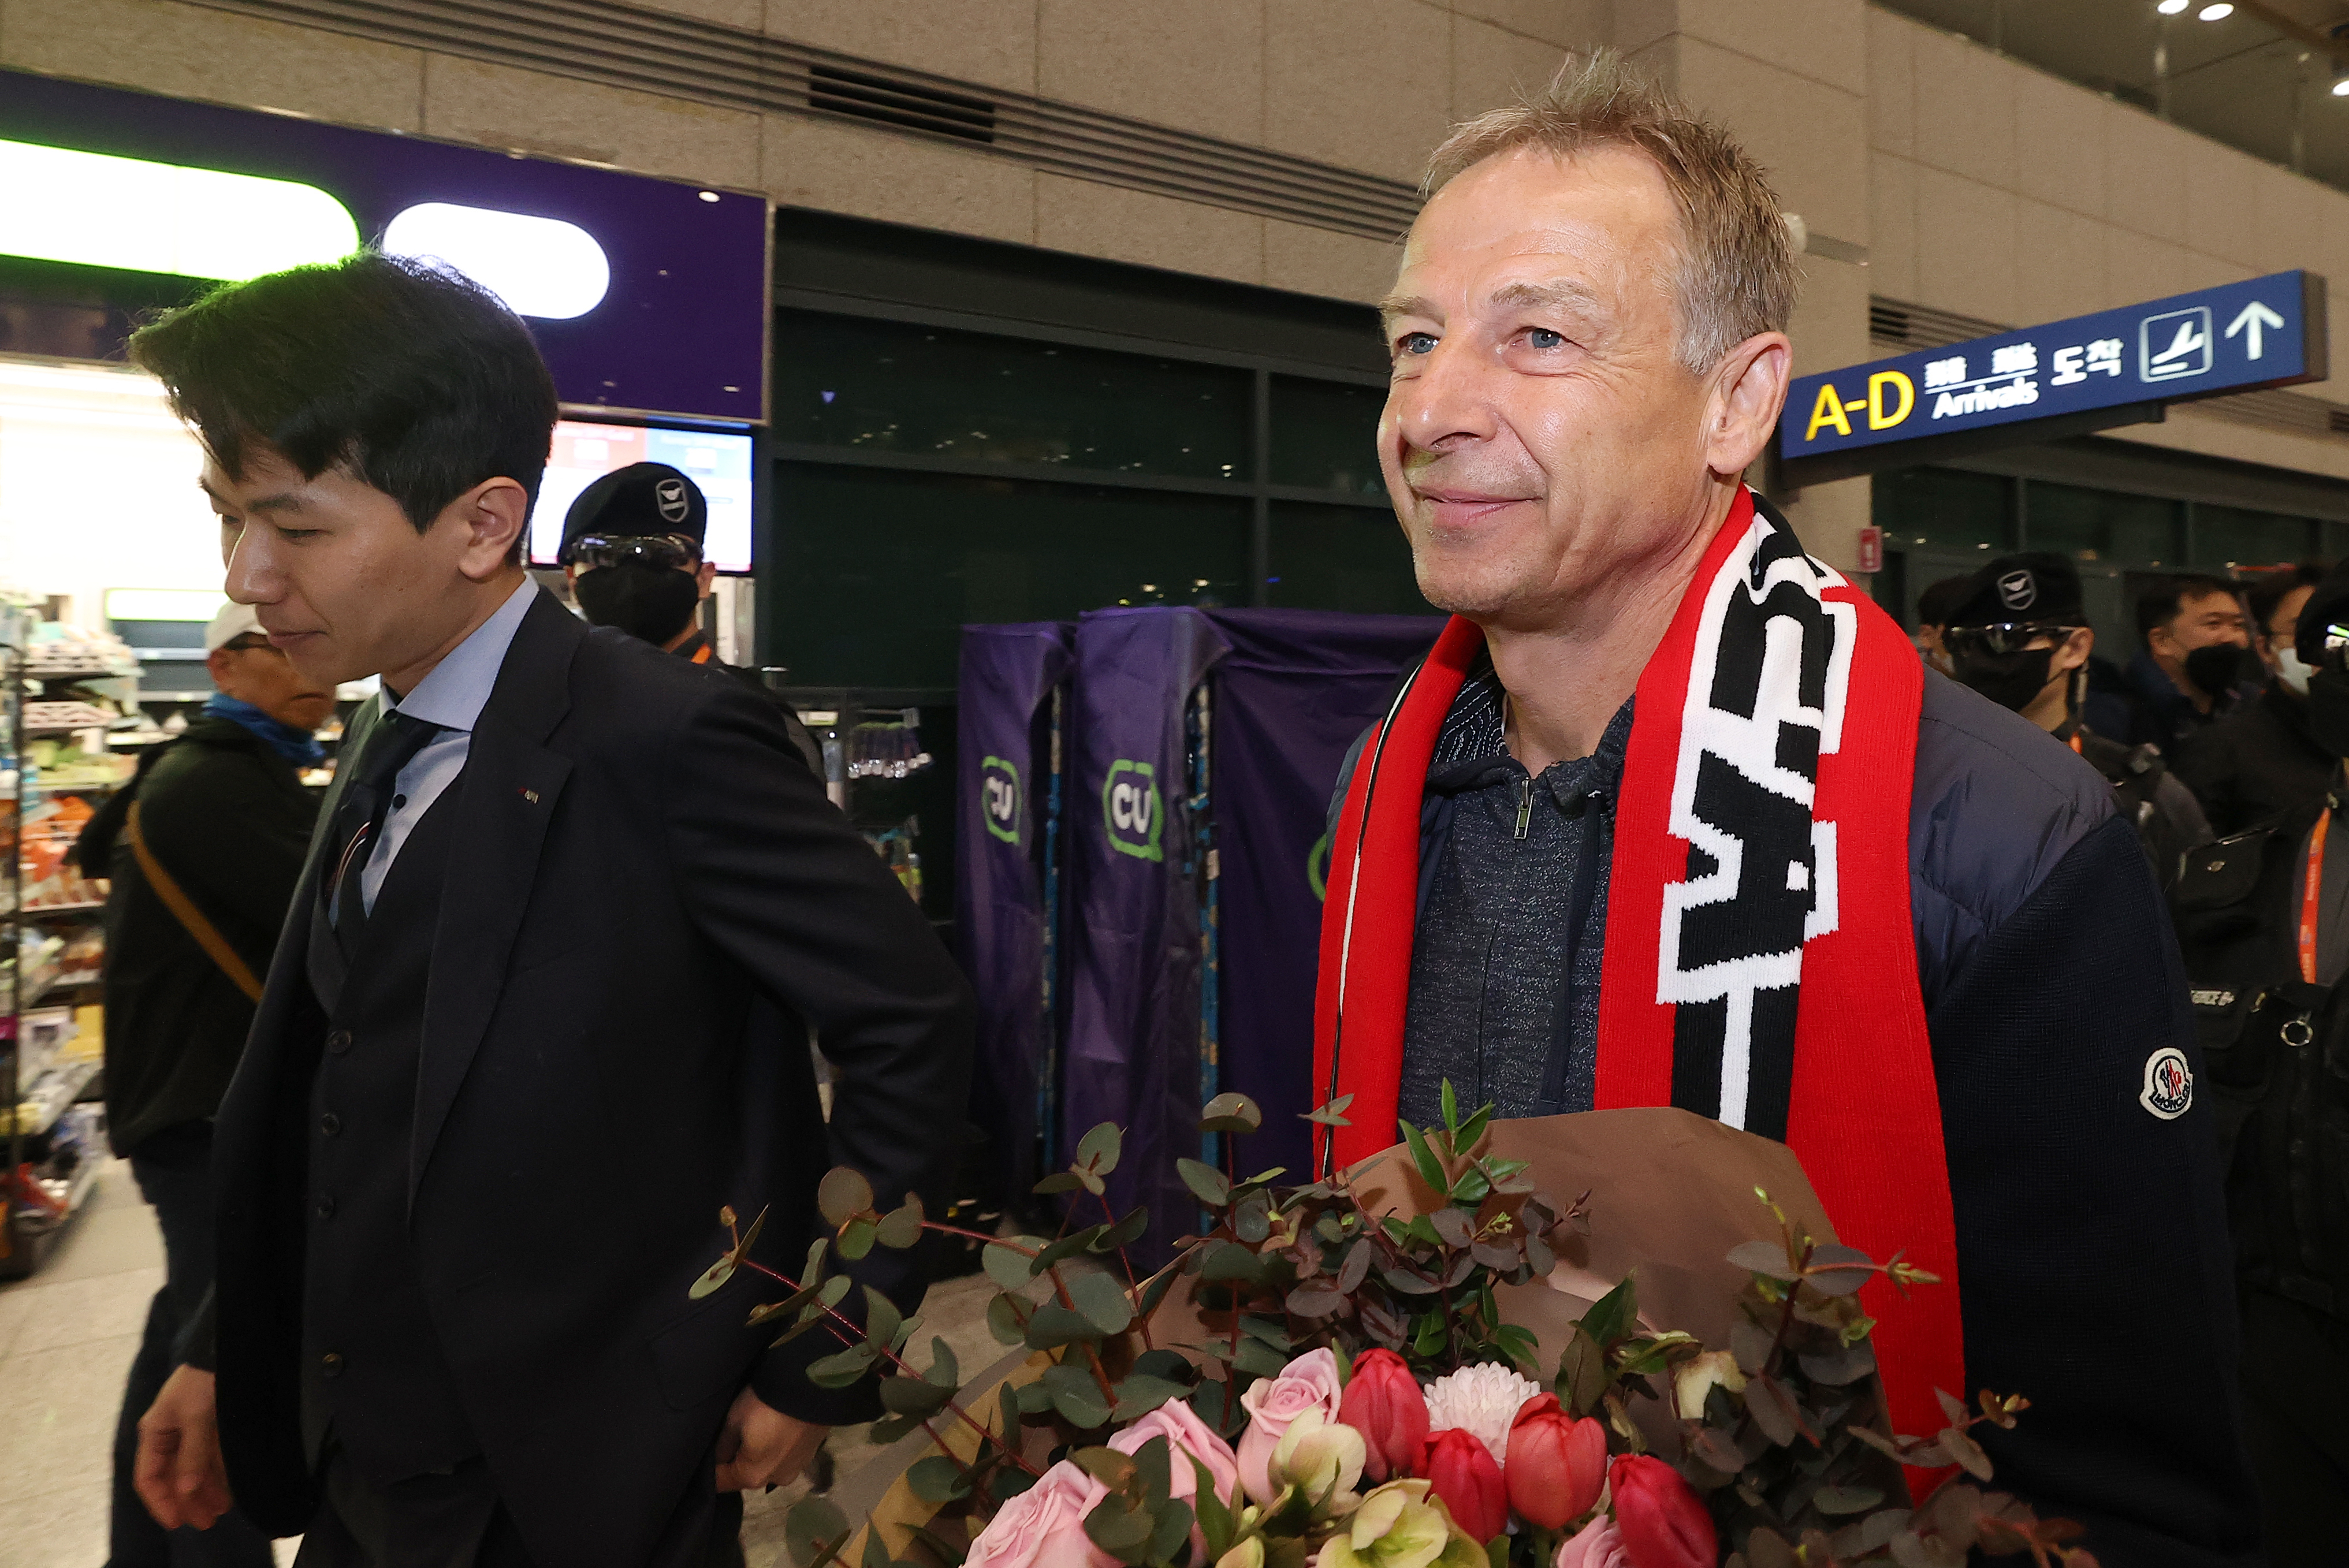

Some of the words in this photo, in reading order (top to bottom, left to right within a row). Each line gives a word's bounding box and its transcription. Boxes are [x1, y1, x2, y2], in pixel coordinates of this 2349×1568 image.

[2050, 338, 2124, 386] 도착
[1804, 370, 1916, 441] A-D
[1931, 377, 2039, 420] Arrivals
[1111, 783, 1152, 833] CU
